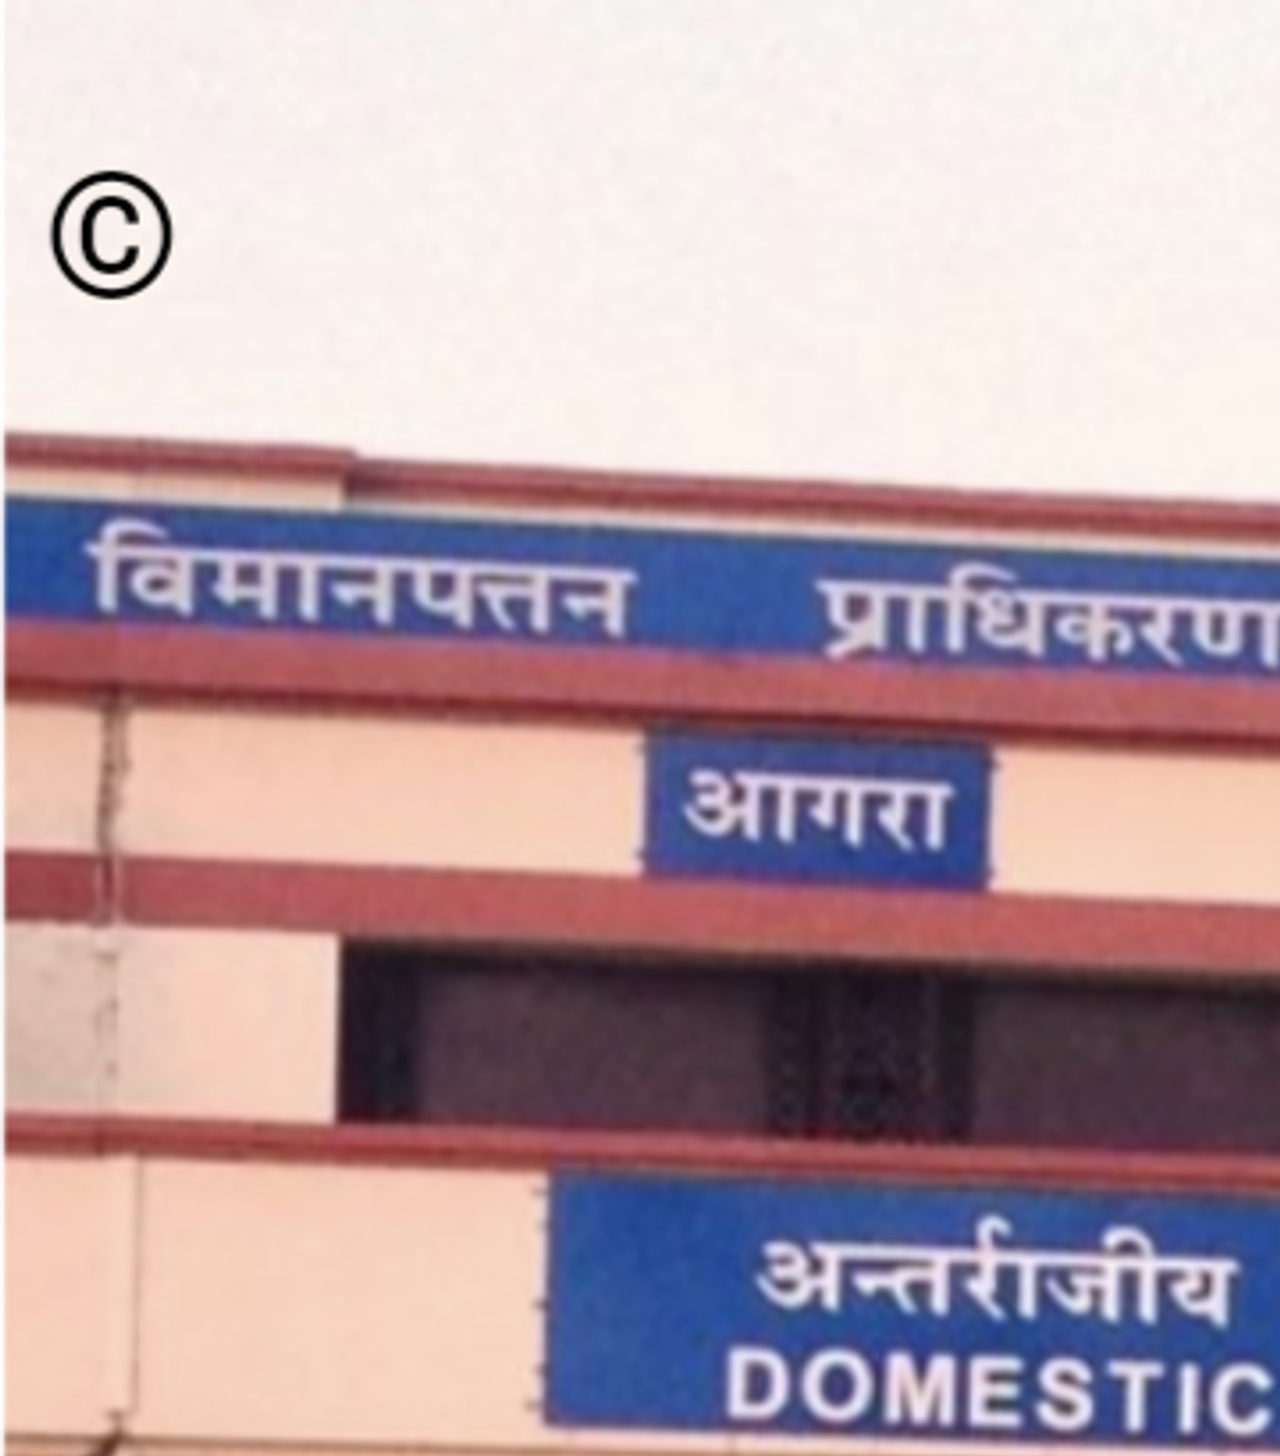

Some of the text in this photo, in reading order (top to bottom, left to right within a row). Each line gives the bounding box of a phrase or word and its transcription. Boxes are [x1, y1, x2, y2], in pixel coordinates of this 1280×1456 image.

[87, 518, 636, 637] विमानपत्तन
[685, 769, 953, 849] आगरा
[726, 1346, 1274, 1437] DOMESTIC
